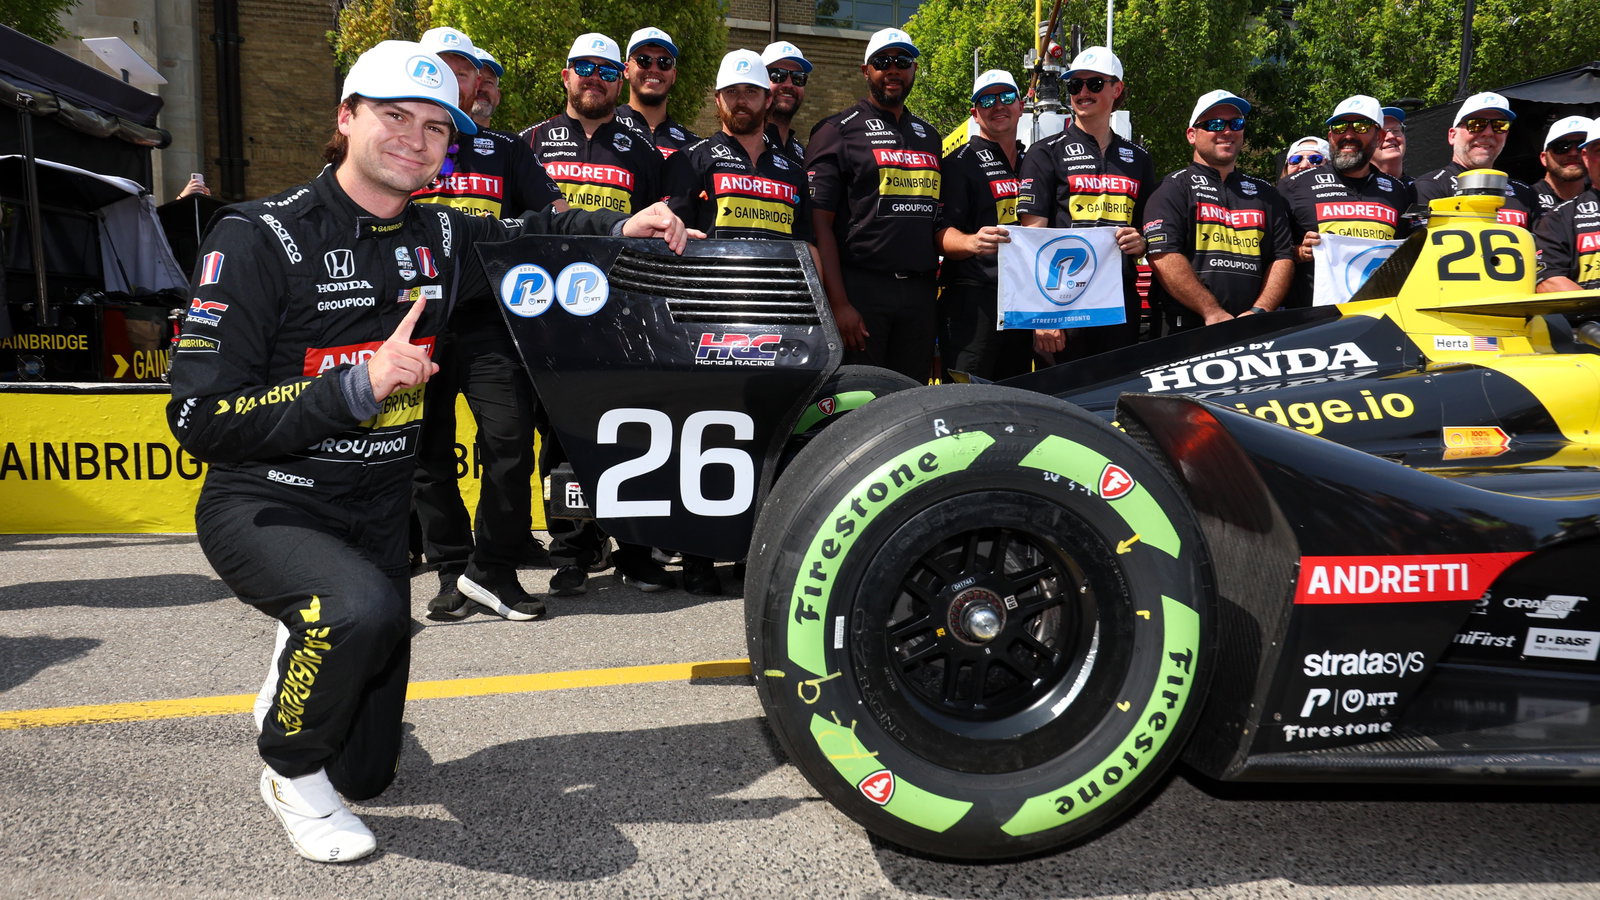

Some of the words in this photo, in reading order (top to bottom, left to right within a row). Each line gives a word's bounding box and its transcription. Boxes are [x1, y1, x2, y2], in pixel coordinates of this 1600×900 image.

[881, 151, 938, 167] ANDRETTI
[546, 164, 630, 186] ANDRETTI
[720, 176, 794, 200] ANDRETTI
[1075, 176, 1138, 194] ANDRETTI
[734, 206, 792, 225] GAINBRIDGE
[1200, 206, 1262, 225] ANDRETTI
[1322, 204, 1396, 222] ANDRETTI
[259, 213, 302, 265] sparco
[1209, 258, 1258, 272] GROUP1001
[1431, 229, 1525, 282] 26
[316, 280, 373, 294] HONDA
[188, 298, 229, 322] RC
[317, 297, 376, 312] GROUP1001
[0, 334, 88, 350] AINBRIDGE
[695, 333, 782, 360] HRC
[1250, 340, 1274, 350] by
[1437, 338, 1468, 348] Herta
[134, 351, 168, 380] GAIN
[1142, 342, 1378, 392] HONDA
[934, 418, 950, 437] R
[308, 436, 406, 458] ROUP1001
[0, 442, 202, 480] AINBRIDG
[596, 408, 755, 518] 26
[266, 468, 314, 487] sparco
[794, 450, 939, 626] Firestone
[1307, 563, 1468, 594] ANDRETTI
[1503, 598, 1577, 612] ORAFOL
[1452, 631, 1516, 648] niFirst
[1554, 636, 1592, 647] BASF
[1303, 649, 1425, 678] stratasys
[1366, 692, 1398, 706] NTT
[1055, 648, 1193, 816] Firestone
[1282, 721, 1392, 742] Firestone
